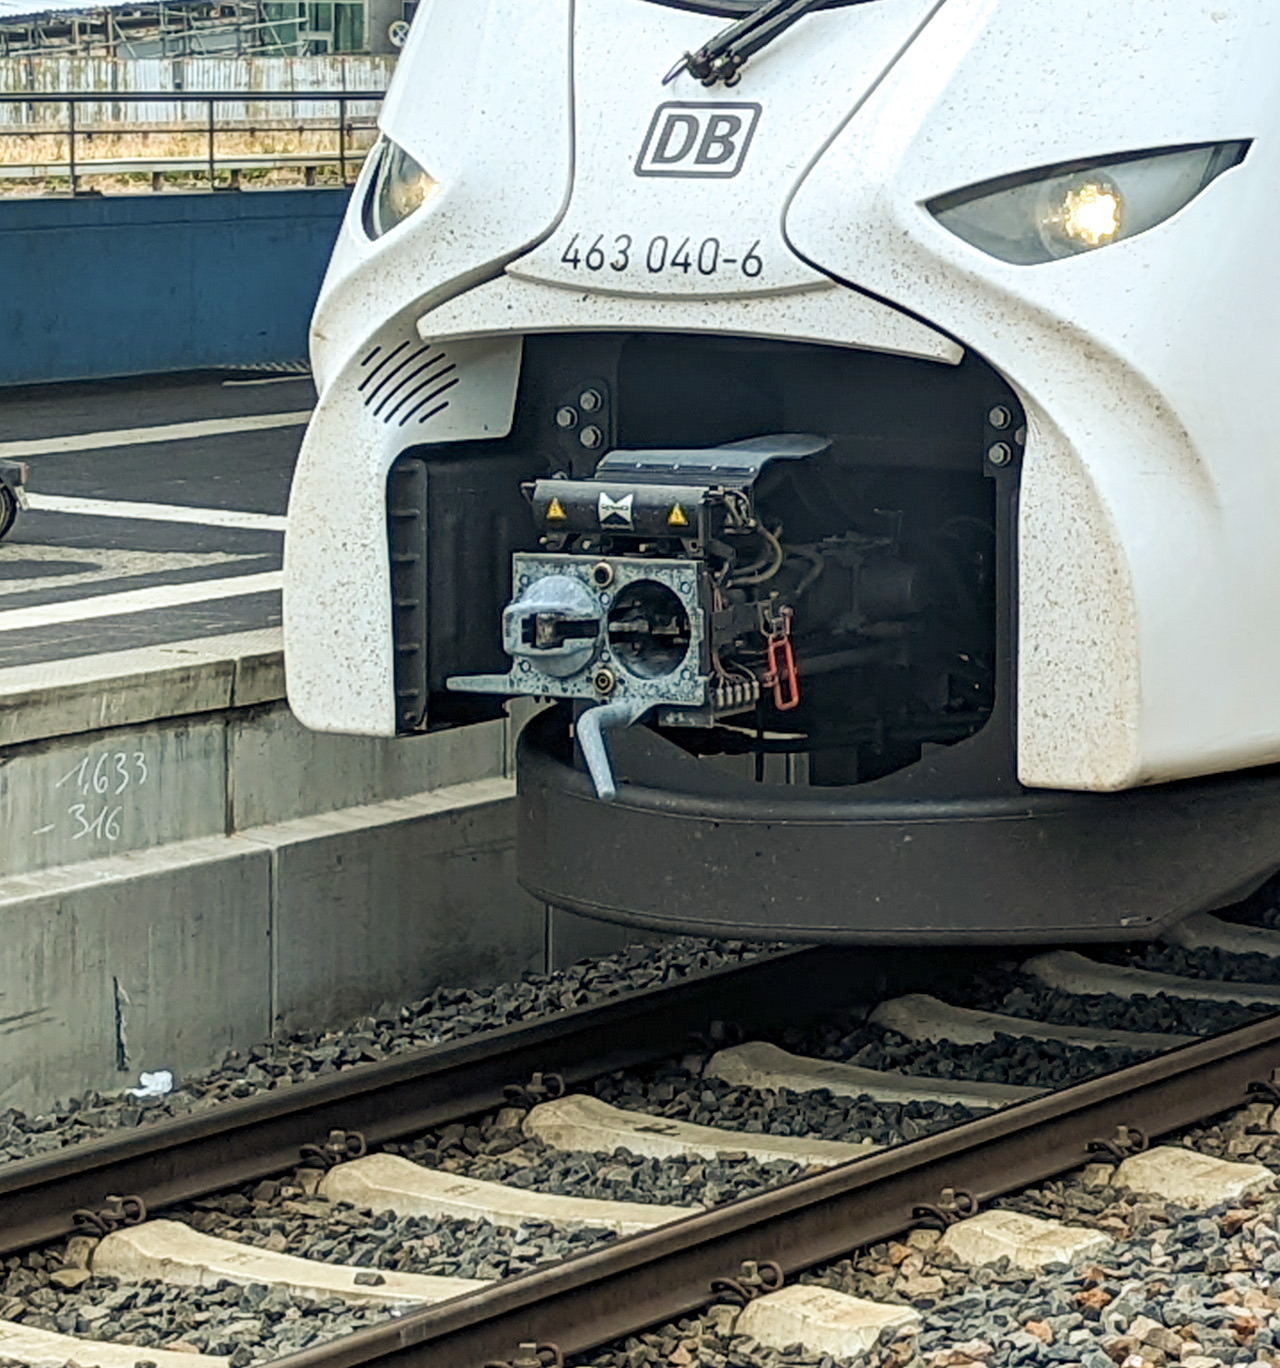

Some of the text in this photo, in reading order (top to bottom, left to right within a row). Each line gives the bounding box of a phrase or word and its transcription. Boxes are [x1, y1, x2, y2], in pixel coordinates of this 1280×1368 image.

[650, 113, 742, 165] DB
[561, 233, 763, 278] 463 040-6
[55, 752, 147, 796] 1,633
